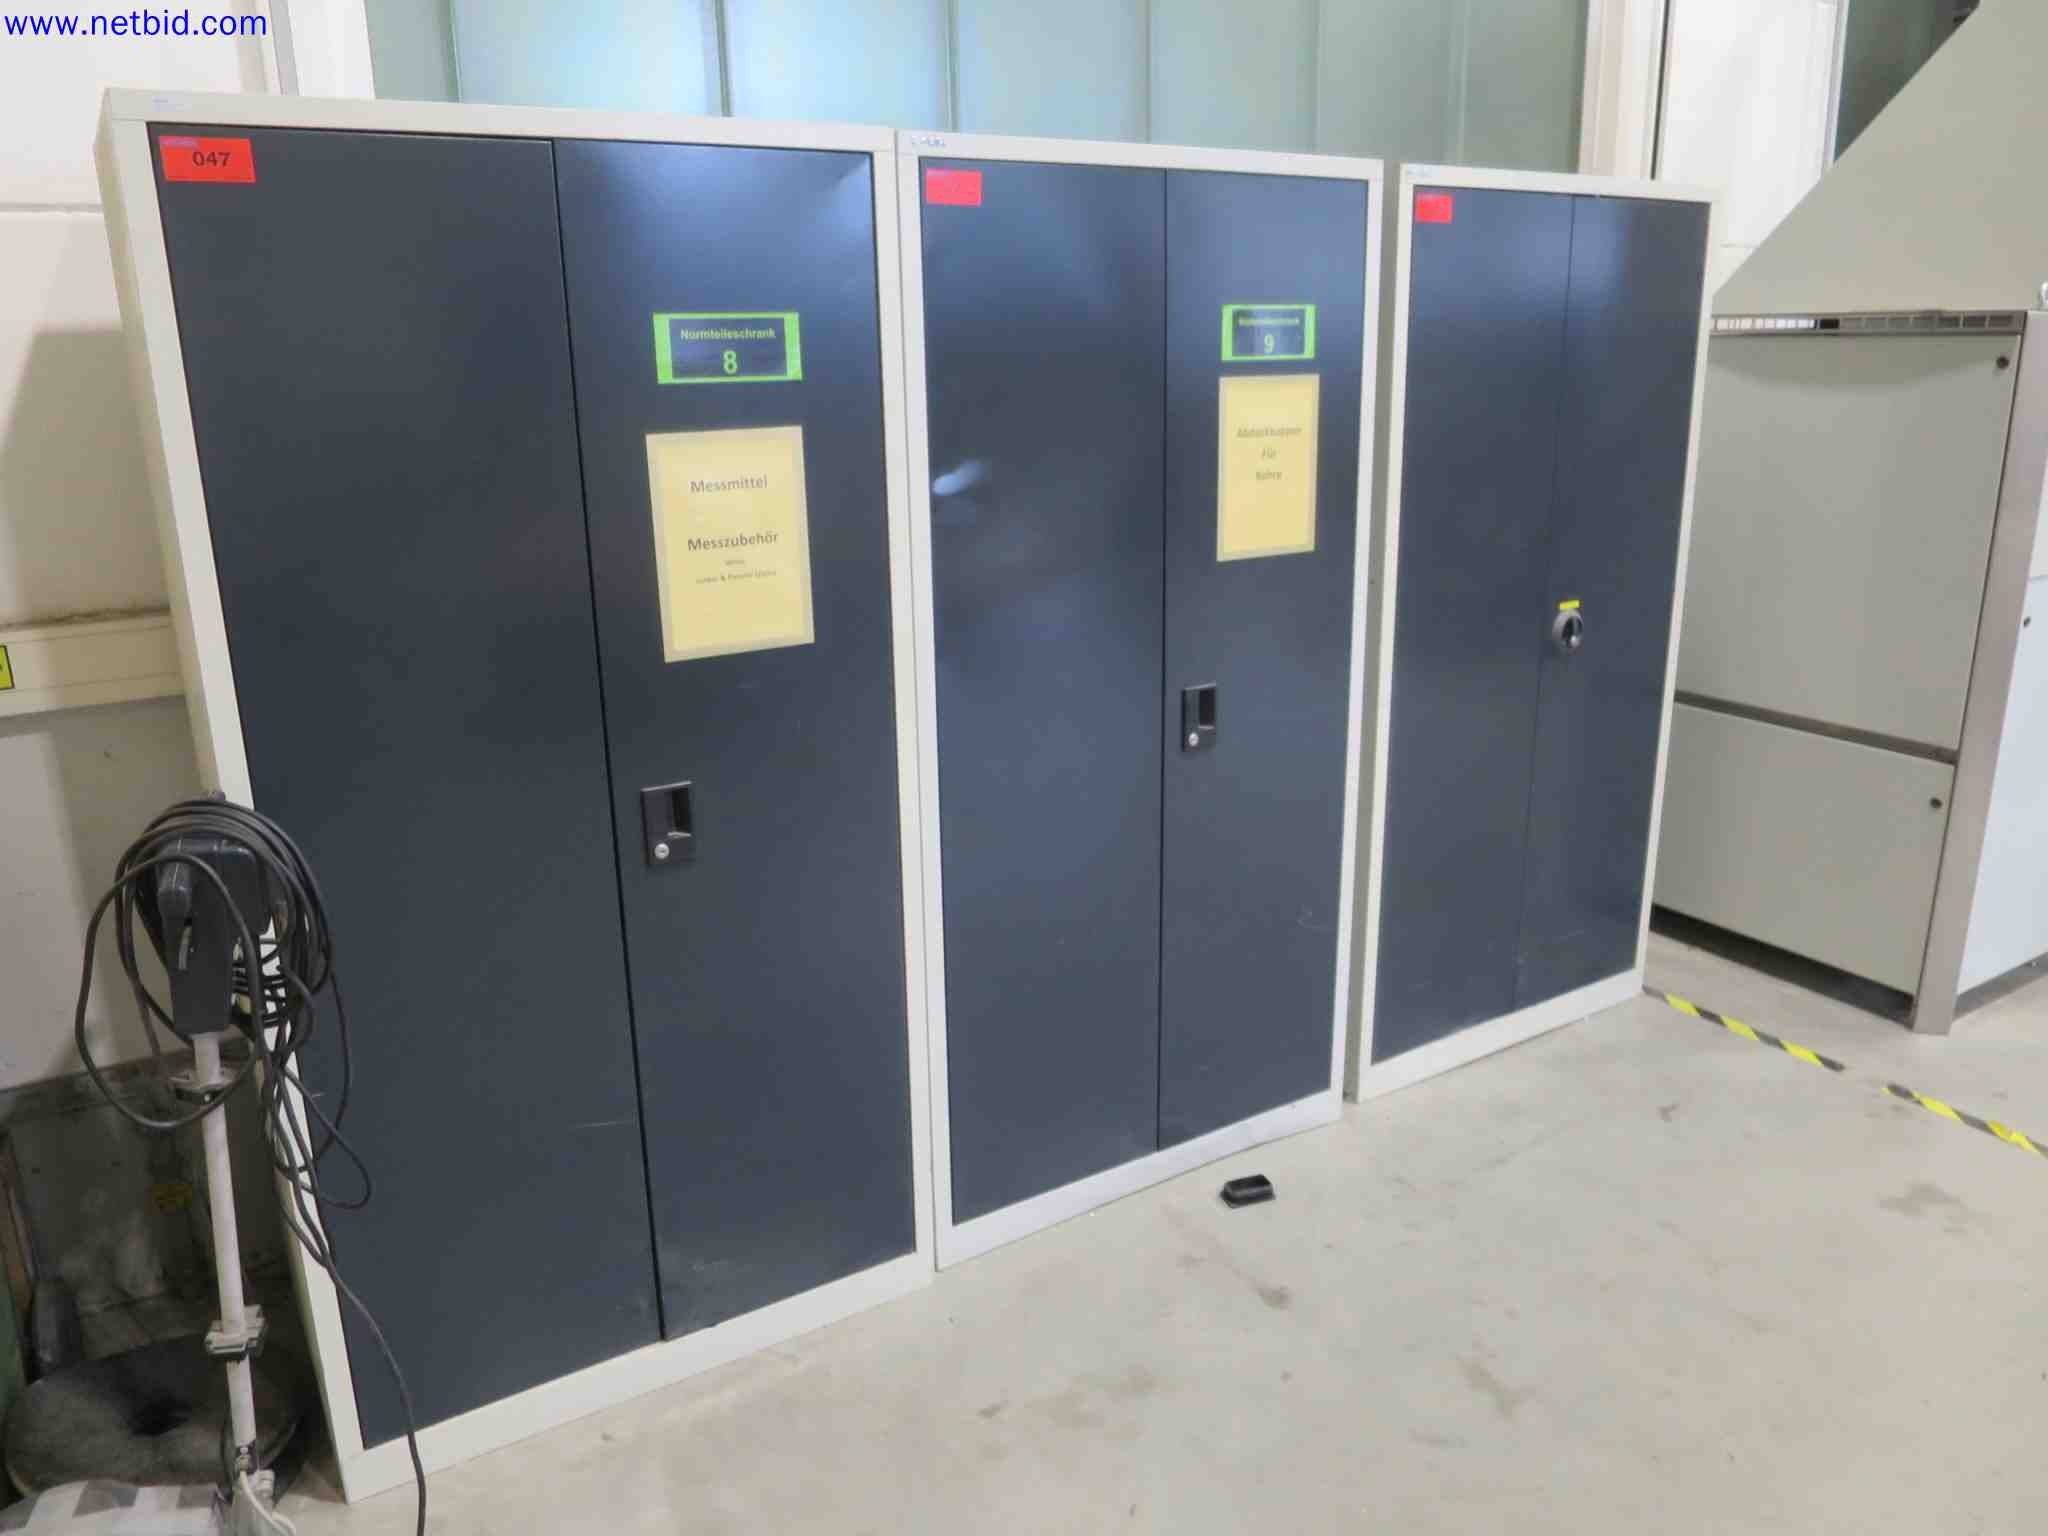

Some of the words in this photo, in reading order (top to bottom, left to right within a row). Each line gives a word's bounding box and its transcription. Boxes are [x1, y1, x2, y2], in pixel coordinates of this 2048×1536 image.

[192, 151, 231, 167] 047
[680, 327, 777, 342] Normteileschrank
[1263, 333, 1276, 354] 9
[723, 349, 738, 374] 8
[690, 474, 768, 494] Messmittel
[687, 529, 779, 552] Messzubehör
